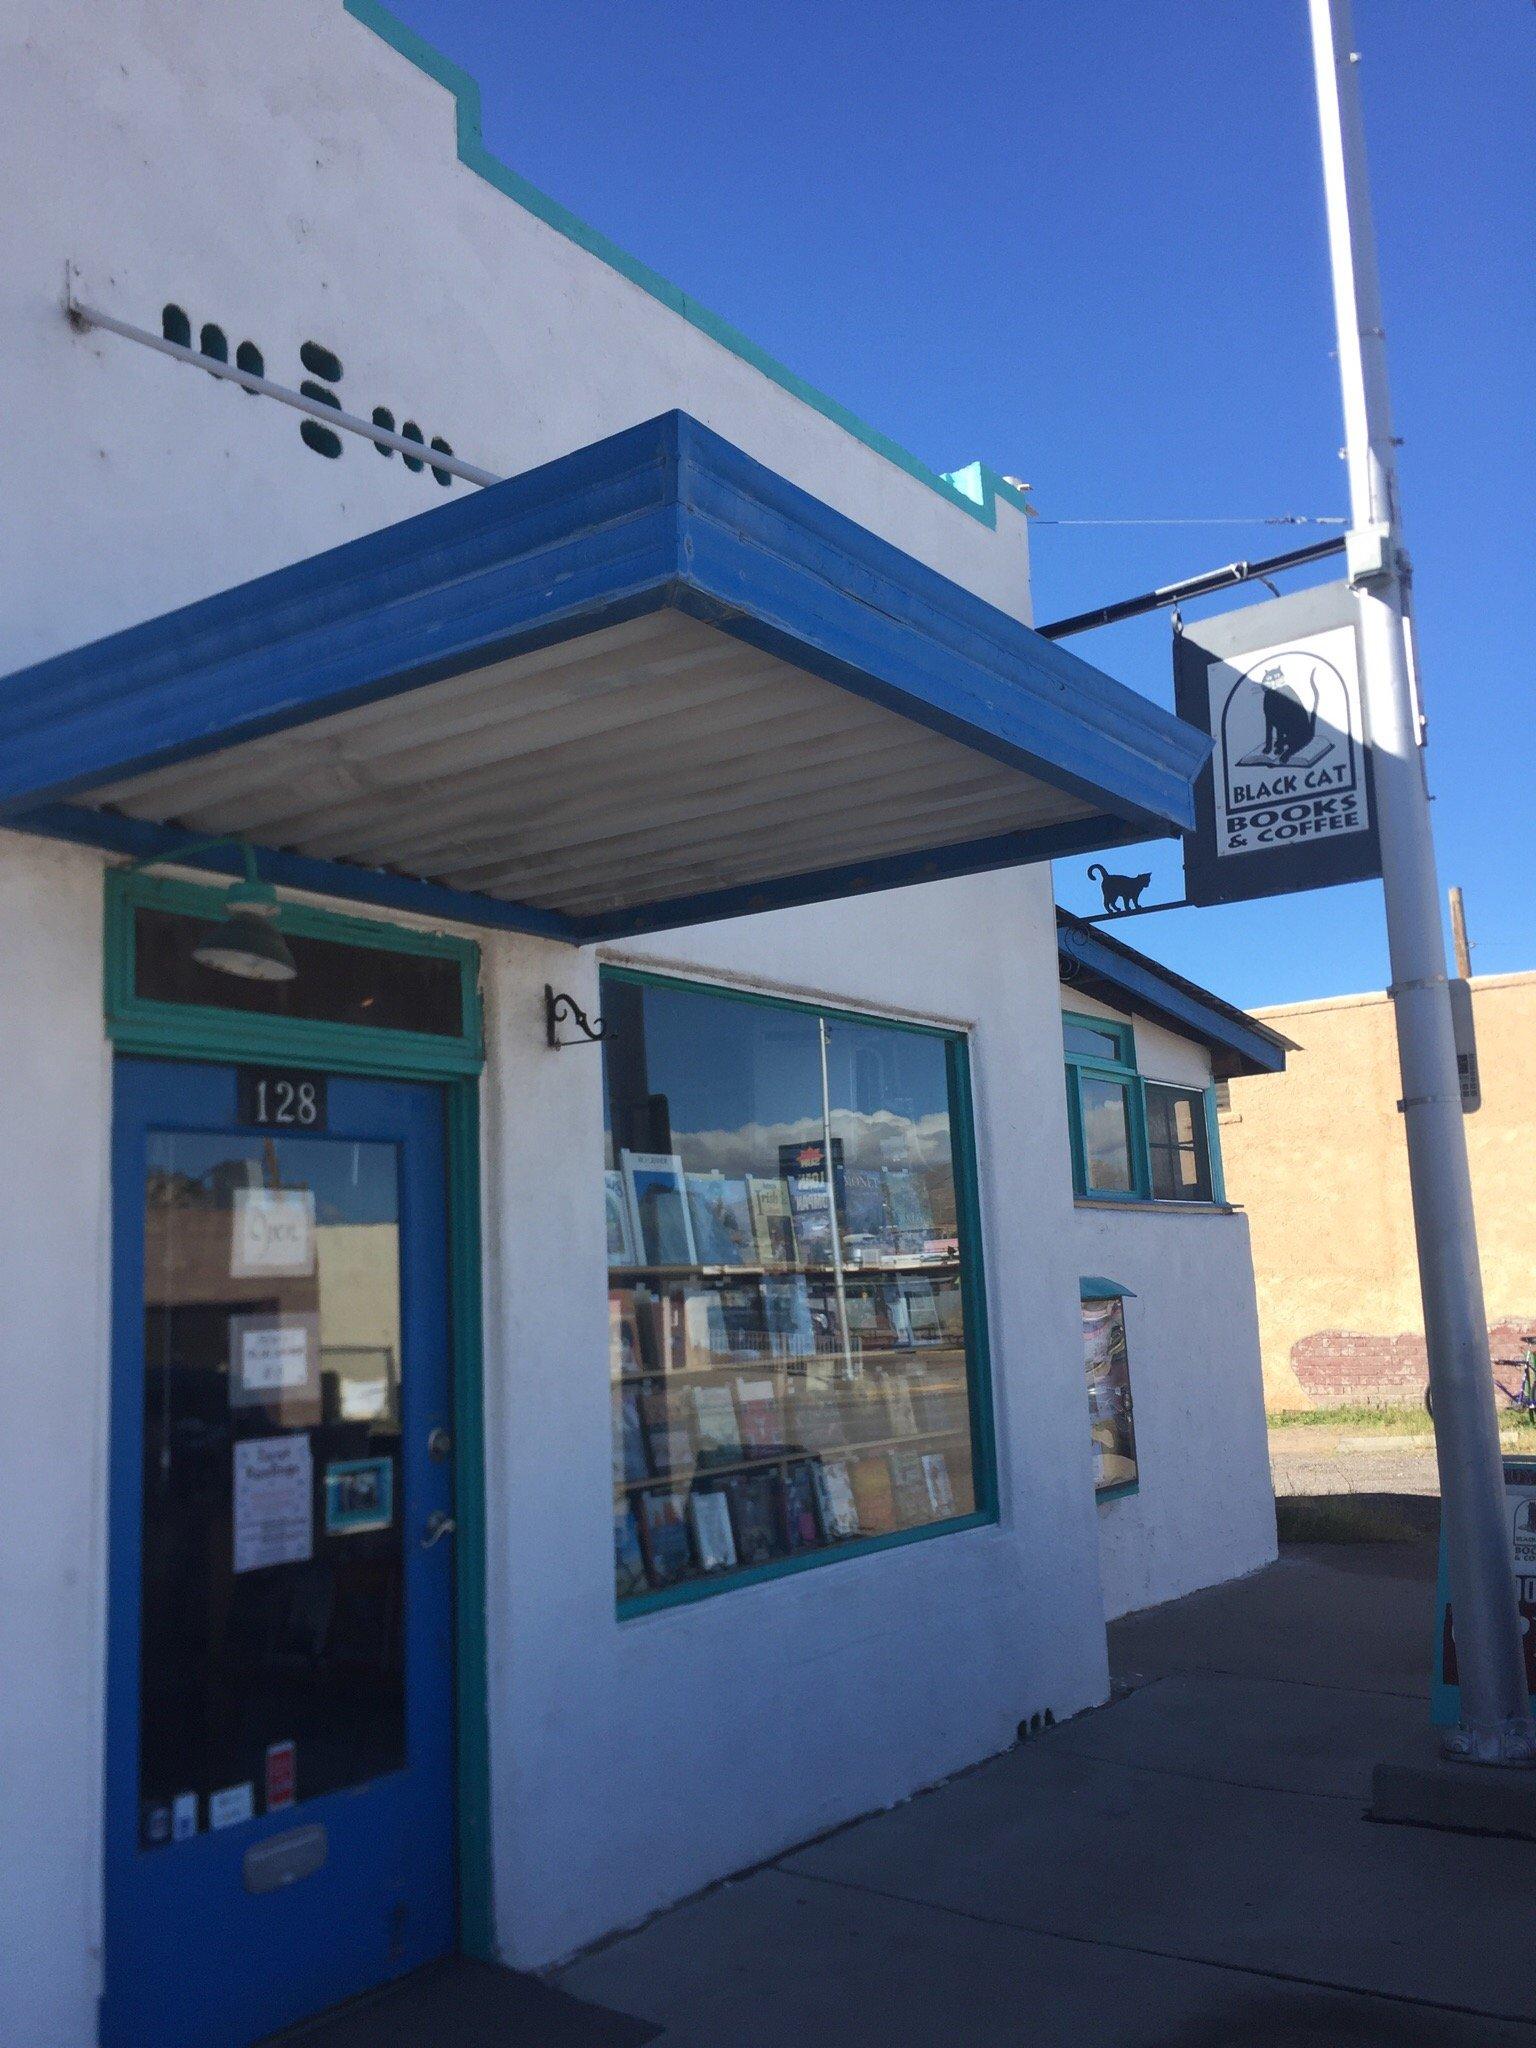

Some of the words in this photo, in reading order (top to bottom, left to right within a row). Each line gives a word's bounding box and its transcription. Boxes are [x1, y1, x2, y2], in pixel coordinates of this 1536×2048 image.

[1233, 775, 1297, 804] BLACK
[1304, 764, 1347, 788] CAT
[1227, 794, 1357, 833] BOOKS
[1228, 834, 1248, 848] &
[1257, 812, 1359, 842] COFFEE
[257, 1081, 317, 1124] 128
